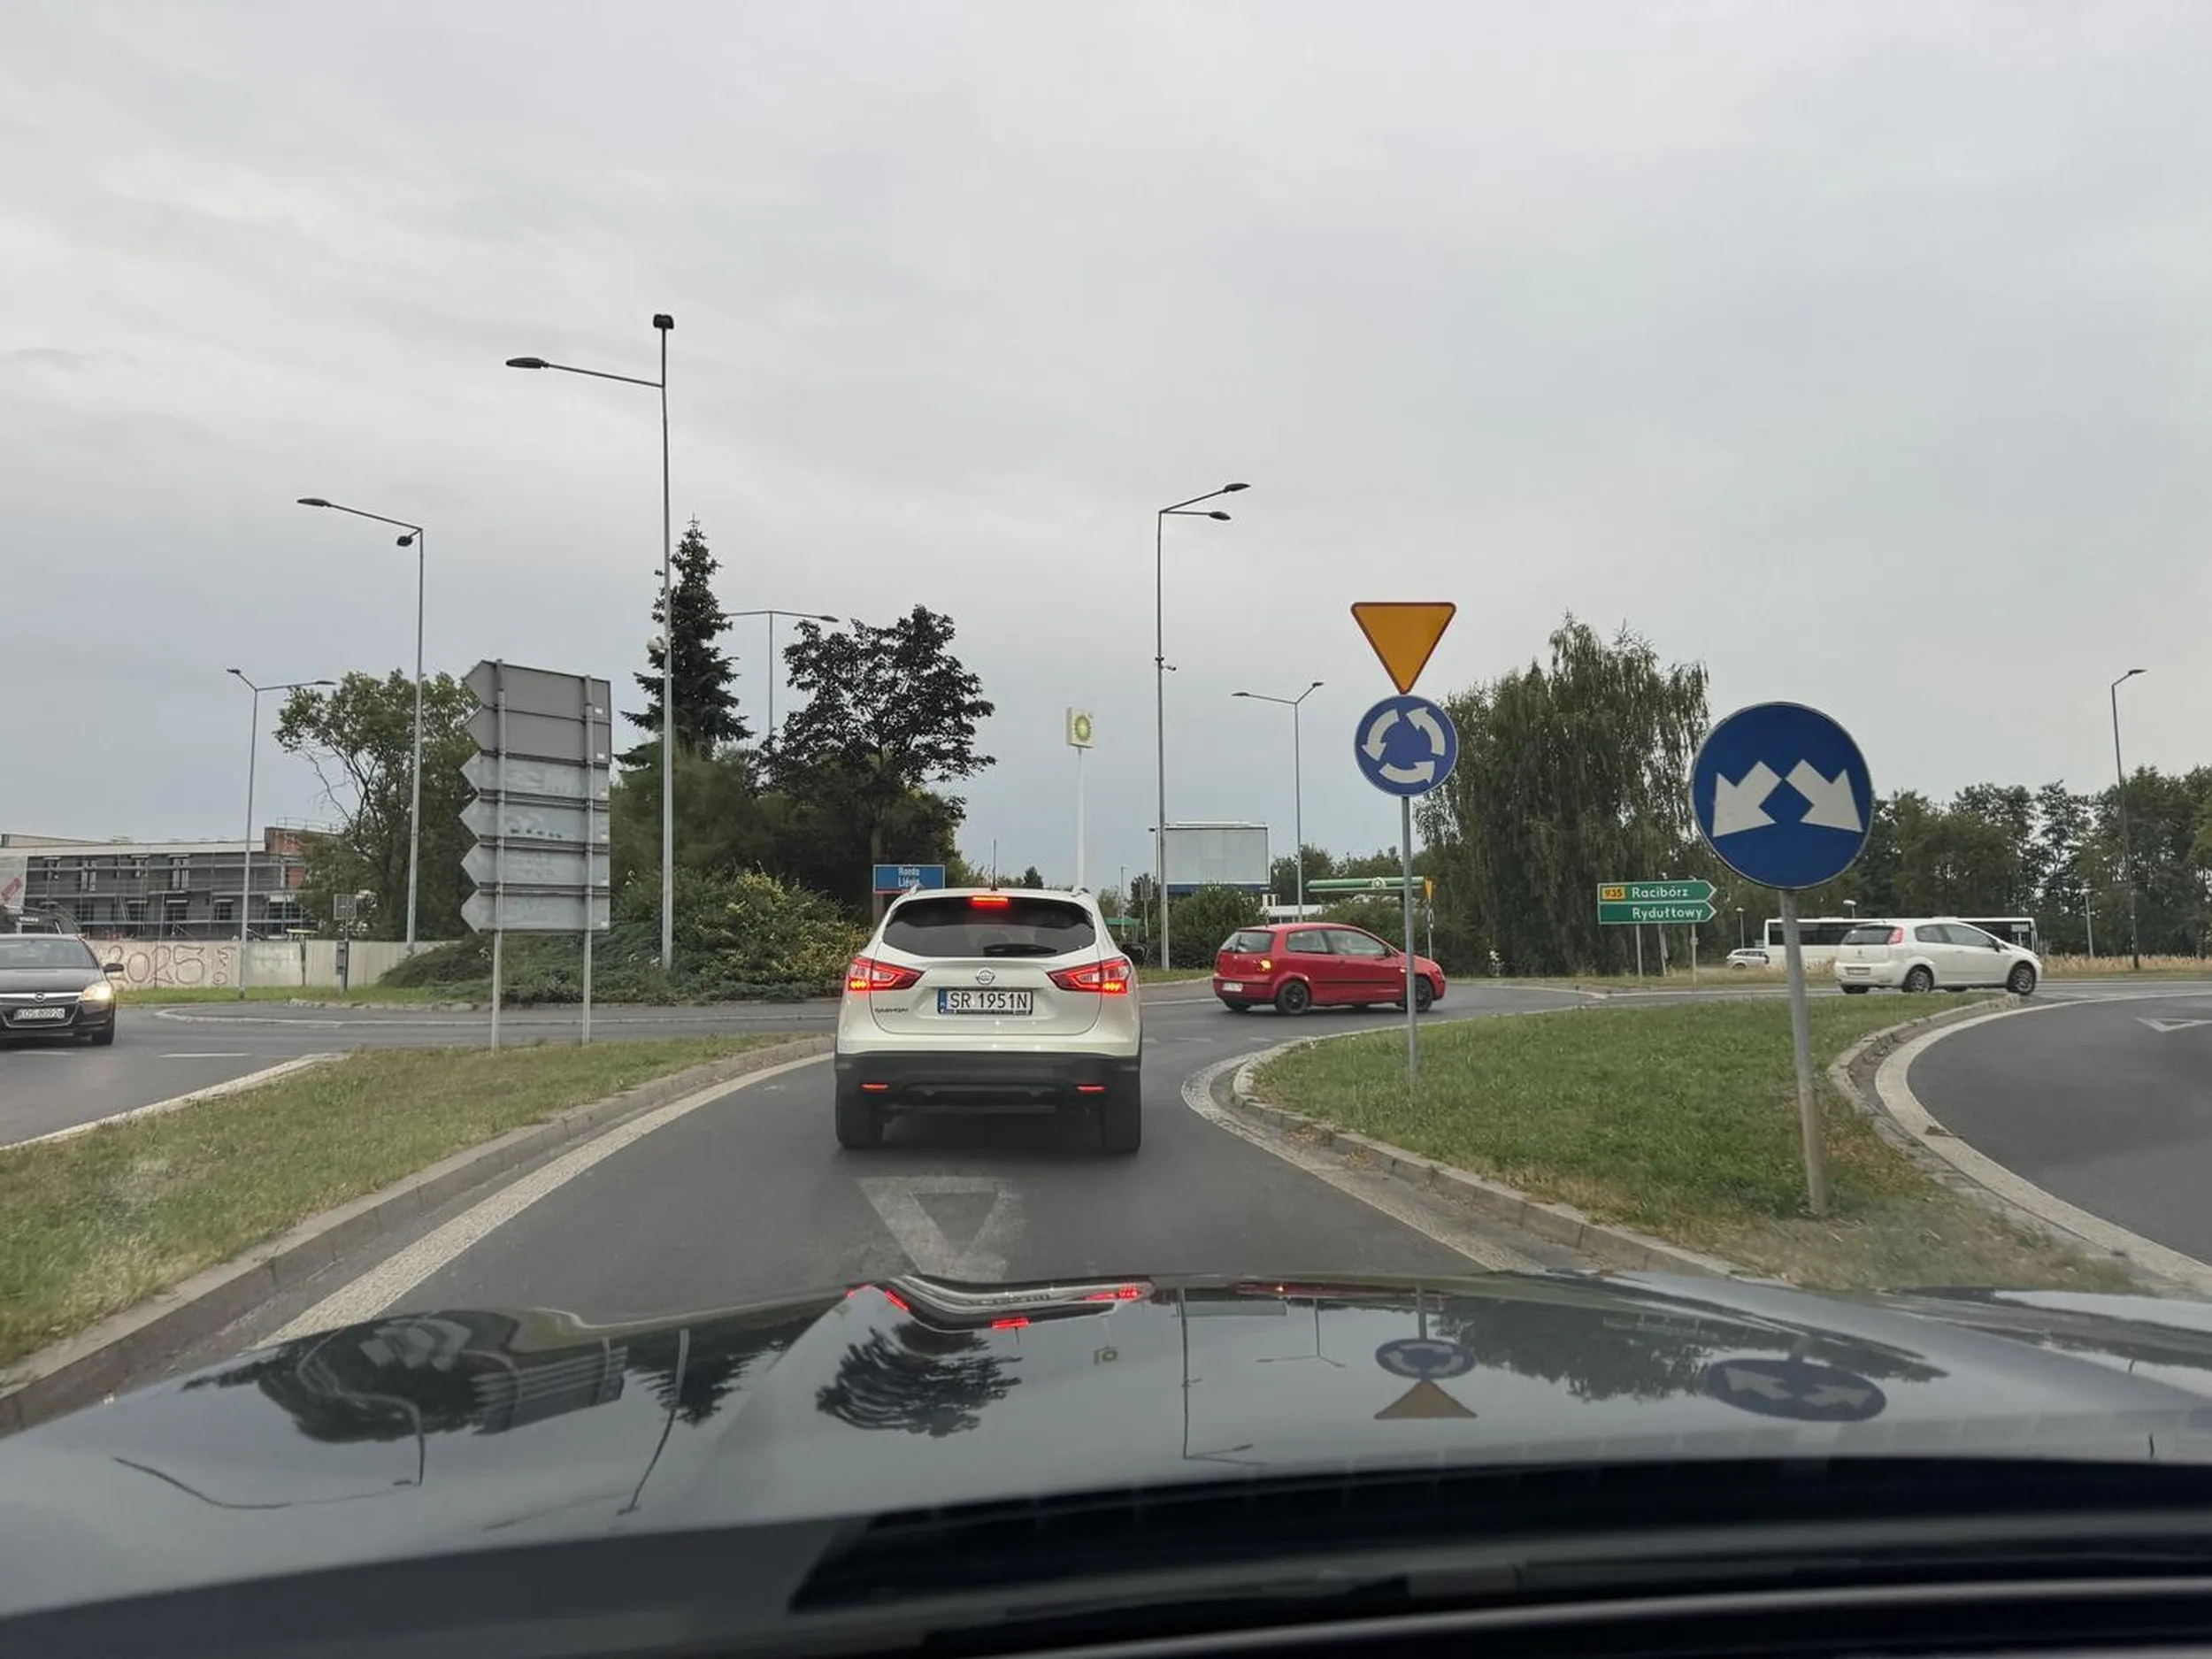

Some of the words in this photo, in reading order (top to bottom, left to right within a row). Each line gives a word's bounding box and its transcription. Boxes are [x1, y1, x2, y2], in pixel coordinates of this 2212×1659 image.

[1605, 888, 1623, 897] 935
[1632, 887, 1688, 898] Racibórz
[1632, 907, 1702, 920] Rydułtowy
[950, 992, 972, 1009] SR
[979, 992, 1027, 1009] 1951N
